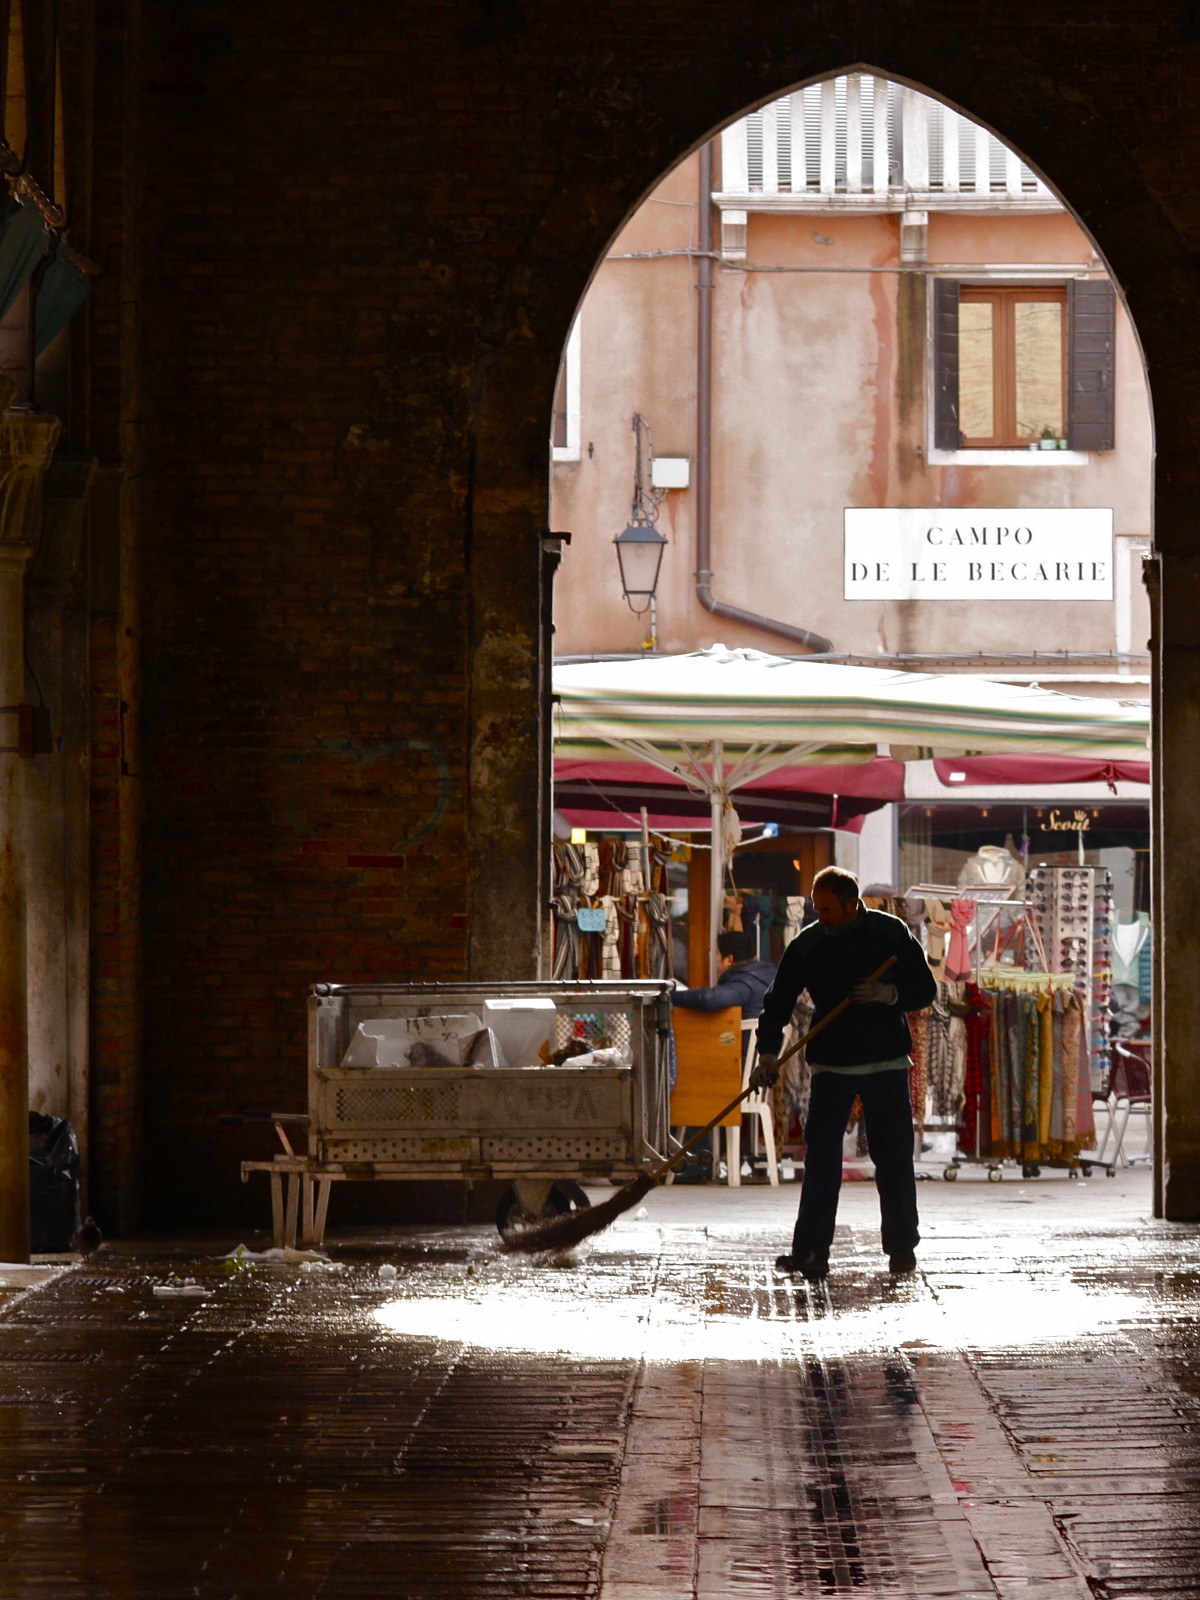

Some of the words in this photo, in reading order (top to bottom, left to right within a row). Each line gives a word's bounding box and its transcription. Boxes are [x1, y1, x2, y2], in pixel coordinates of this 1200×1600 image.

[926, 526, 1033, 546] CAMPO
[850, 562, 890, 582] DE
[911, 562, 947, 582] LE
[968, 562, 1106, 582] BECARIE
[1040, 809, 1091, 832] Scout
